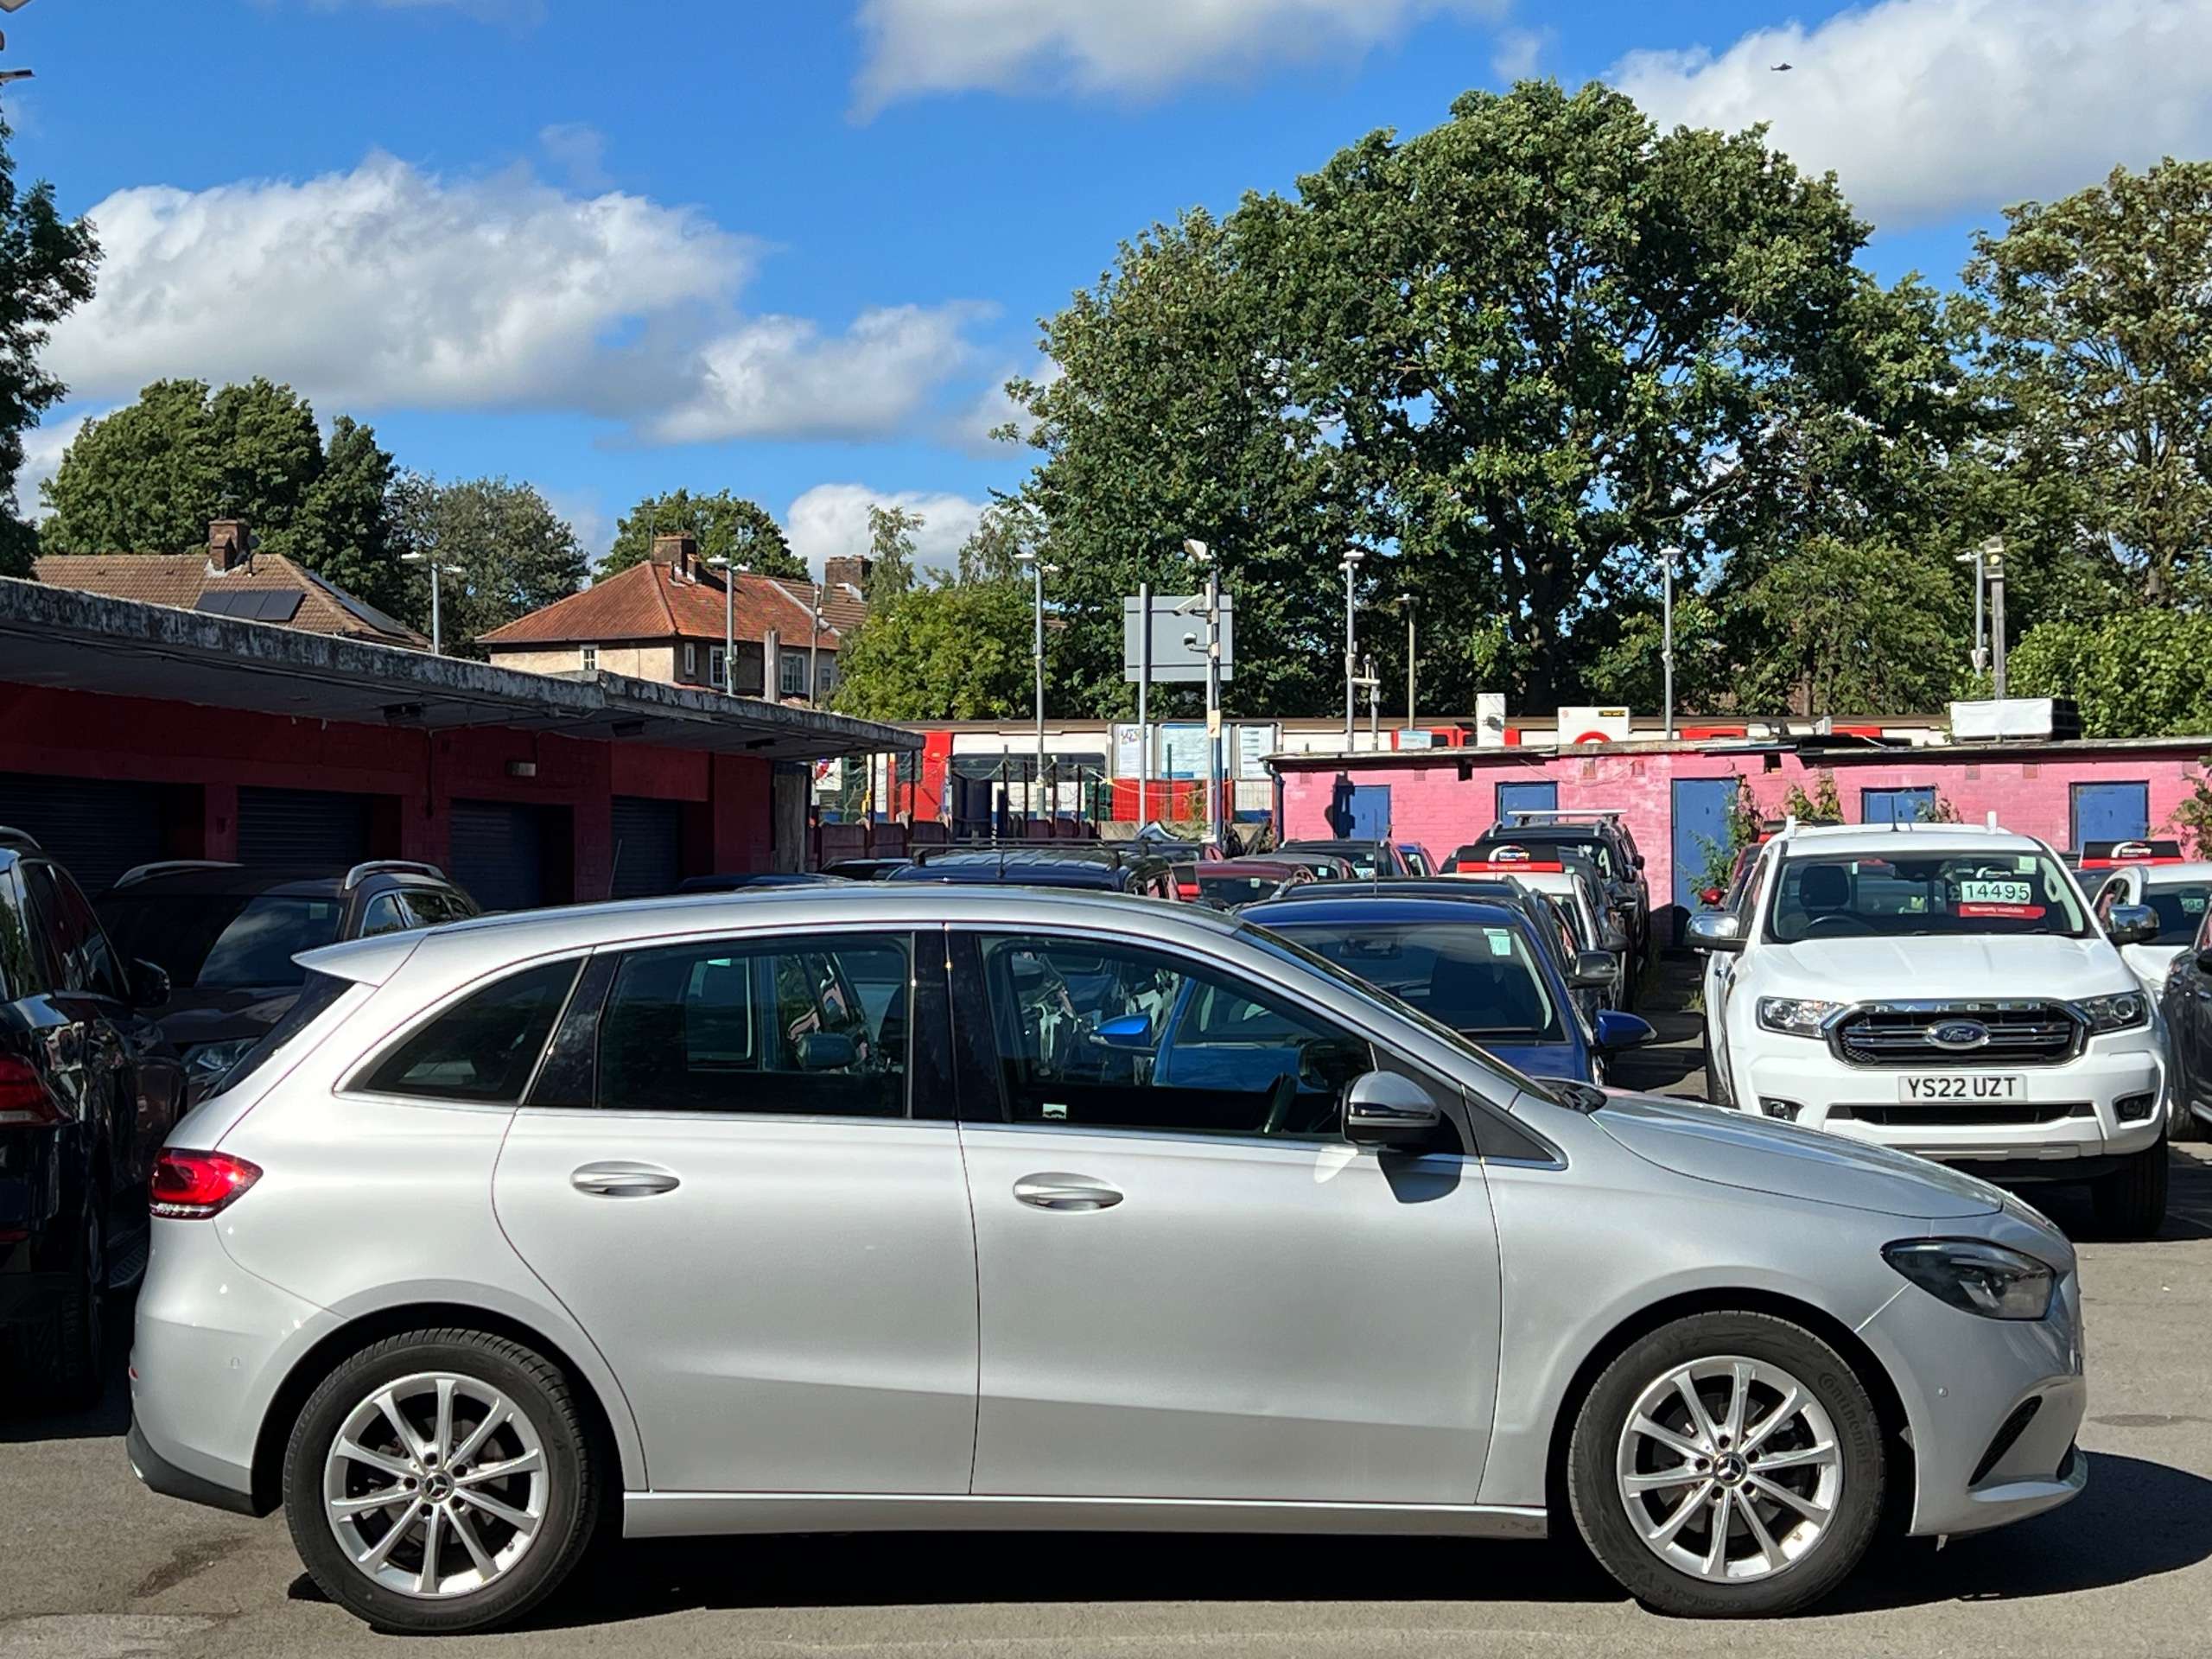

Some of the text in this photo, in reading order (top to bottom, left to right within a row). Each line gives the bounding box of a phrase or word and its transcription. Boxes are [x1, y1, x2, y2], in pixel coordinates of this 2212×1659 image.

[1966, 884, 2030, 900] 14495
[1874, 1002, 2041, 1013] RANGER
[1942, 1027, 1974, 1041] Ford
[1908, 1077, 2017, 1097] YS22 UZT
